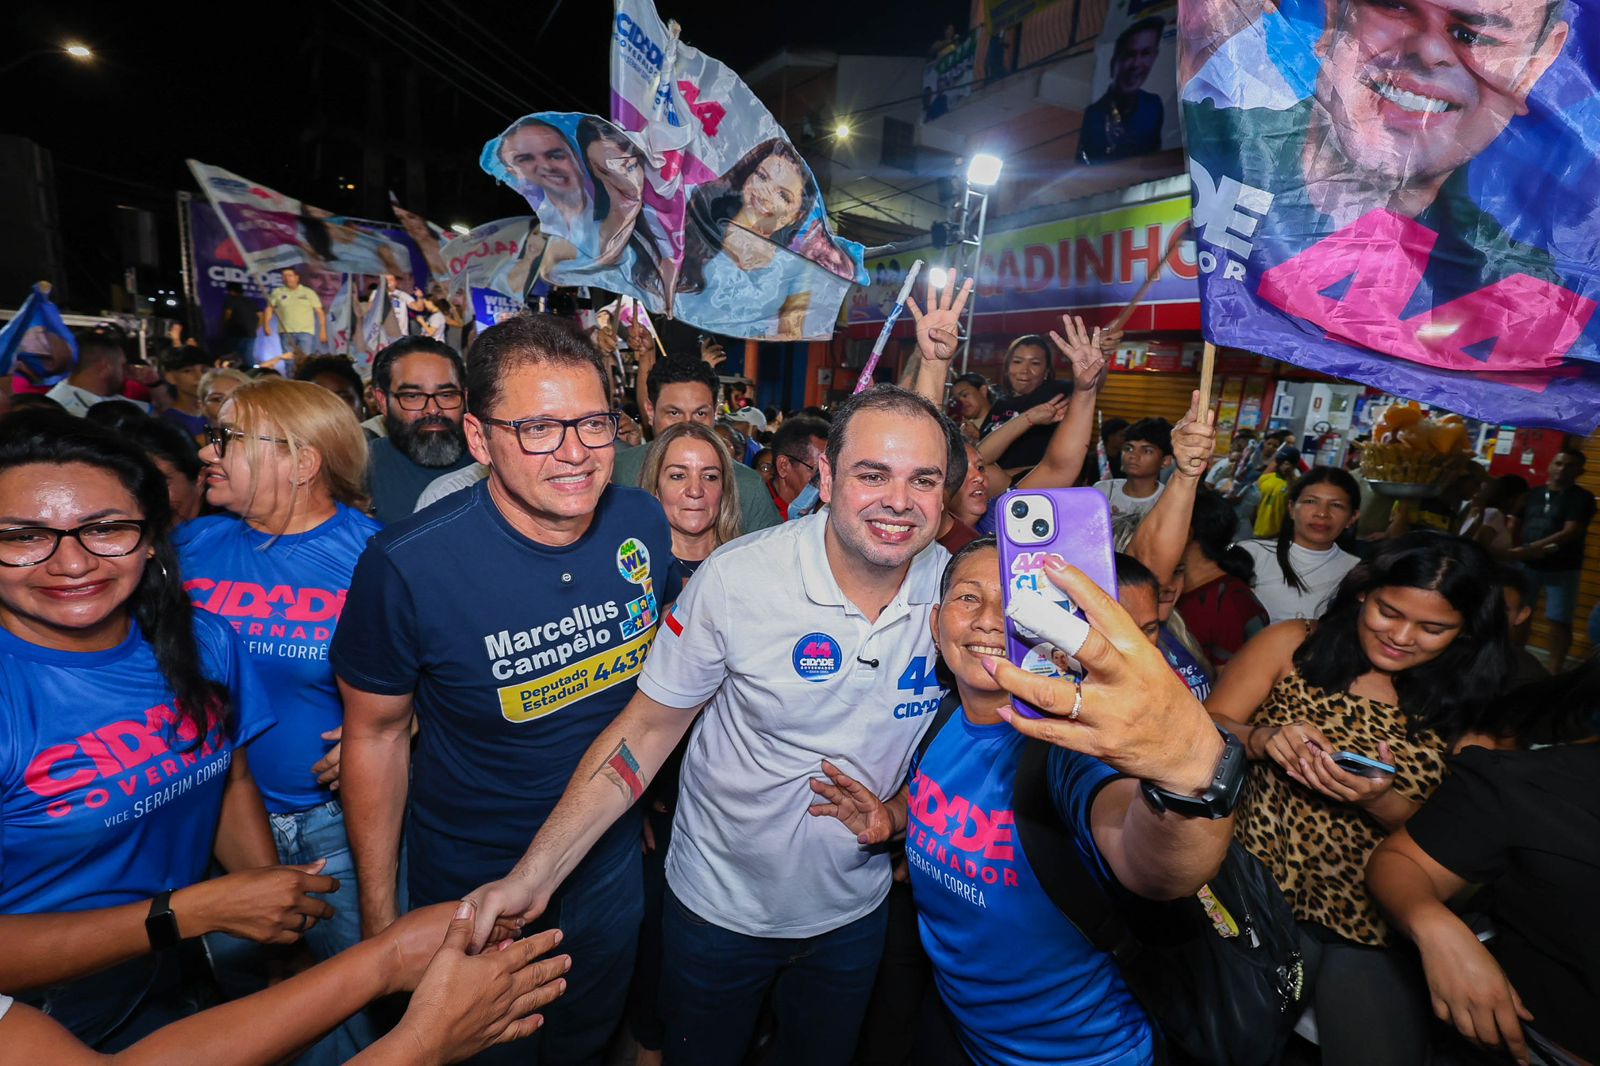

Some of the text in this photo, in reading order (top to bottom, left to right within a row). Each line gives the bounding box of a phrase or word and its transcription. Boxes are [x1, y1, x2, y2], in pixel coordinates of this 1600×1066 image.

[616, 13, 664, 71] CIDAD
[1256, 207, 1599, 392] 44
[230, 621, 330, 641] ERNAD
[278, 643, 329, 661] CORRÊ
[484, 600, 619, 661] Marcellus
[803, 642, 832, 658] 44
[492, 628, 611, 680] Campêlo
[800, 658, 834, 667] CIDADE
[520, 668, 588, 701] Deputado
[522, 679, 589, 713] Estadual
[893, 698, 941, 720] CIDAD
[104, 811, 129, 828] VICE
[133, 776, 192, 819] SERAFIM
[907, 816, 1019, 887] VERNADOR
[908, 846, 987, 909] SERAFIM CORRÊA
